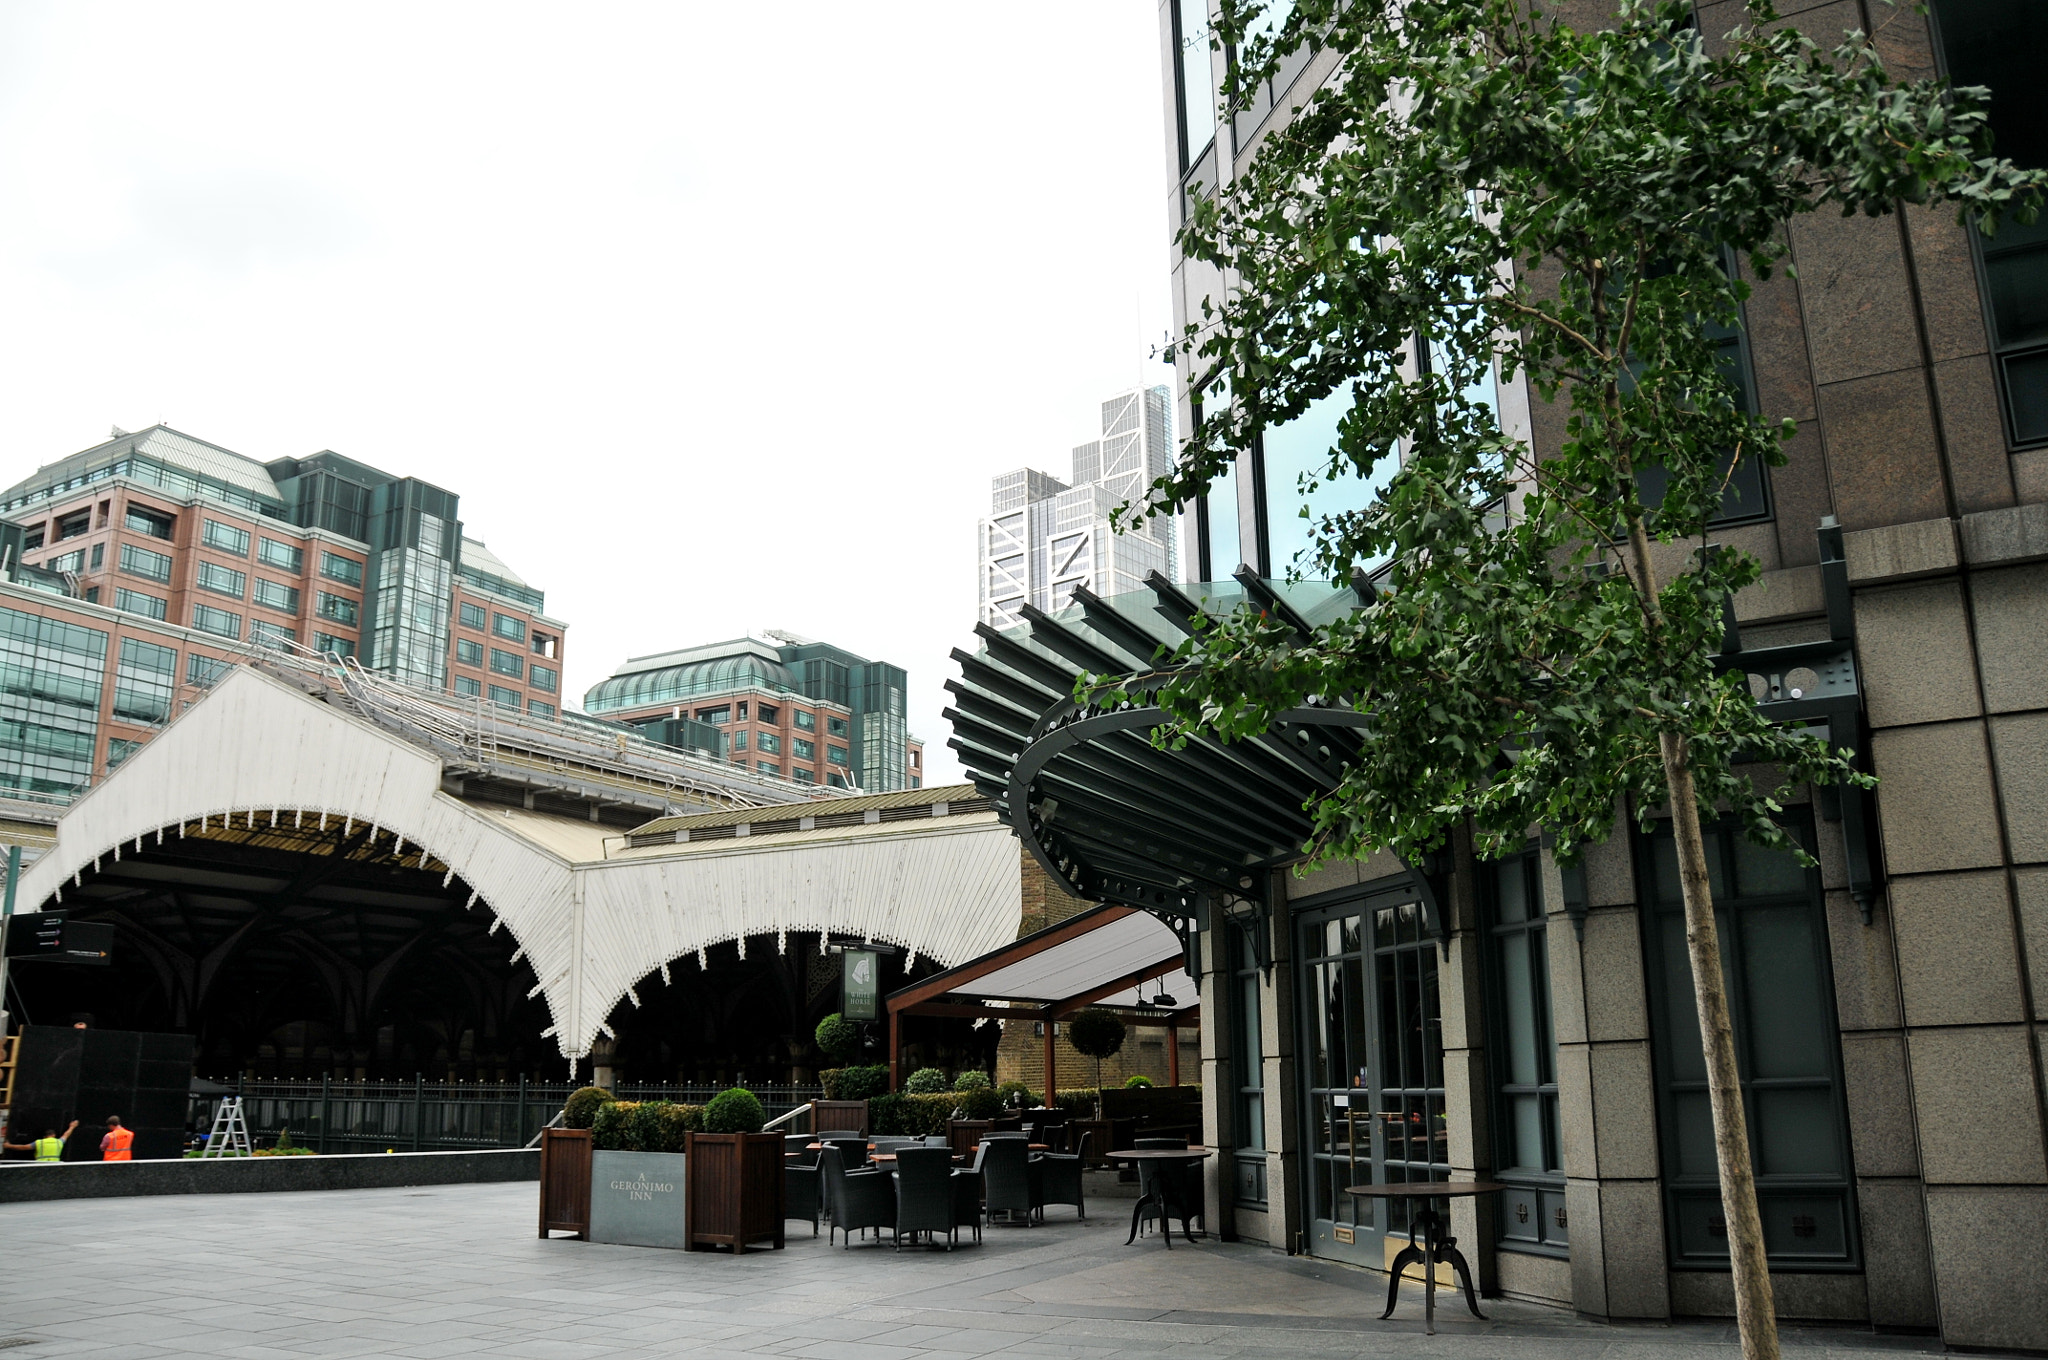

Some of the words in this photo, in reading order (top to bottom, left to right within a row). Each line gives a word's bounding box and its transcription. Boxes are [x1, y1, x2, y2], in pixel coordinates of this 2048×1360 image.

[638, 1173, 646, 1181] A
[610, 1181, 673, 1192] GERONIMO
[630, 1191, 652, 1200] INN
